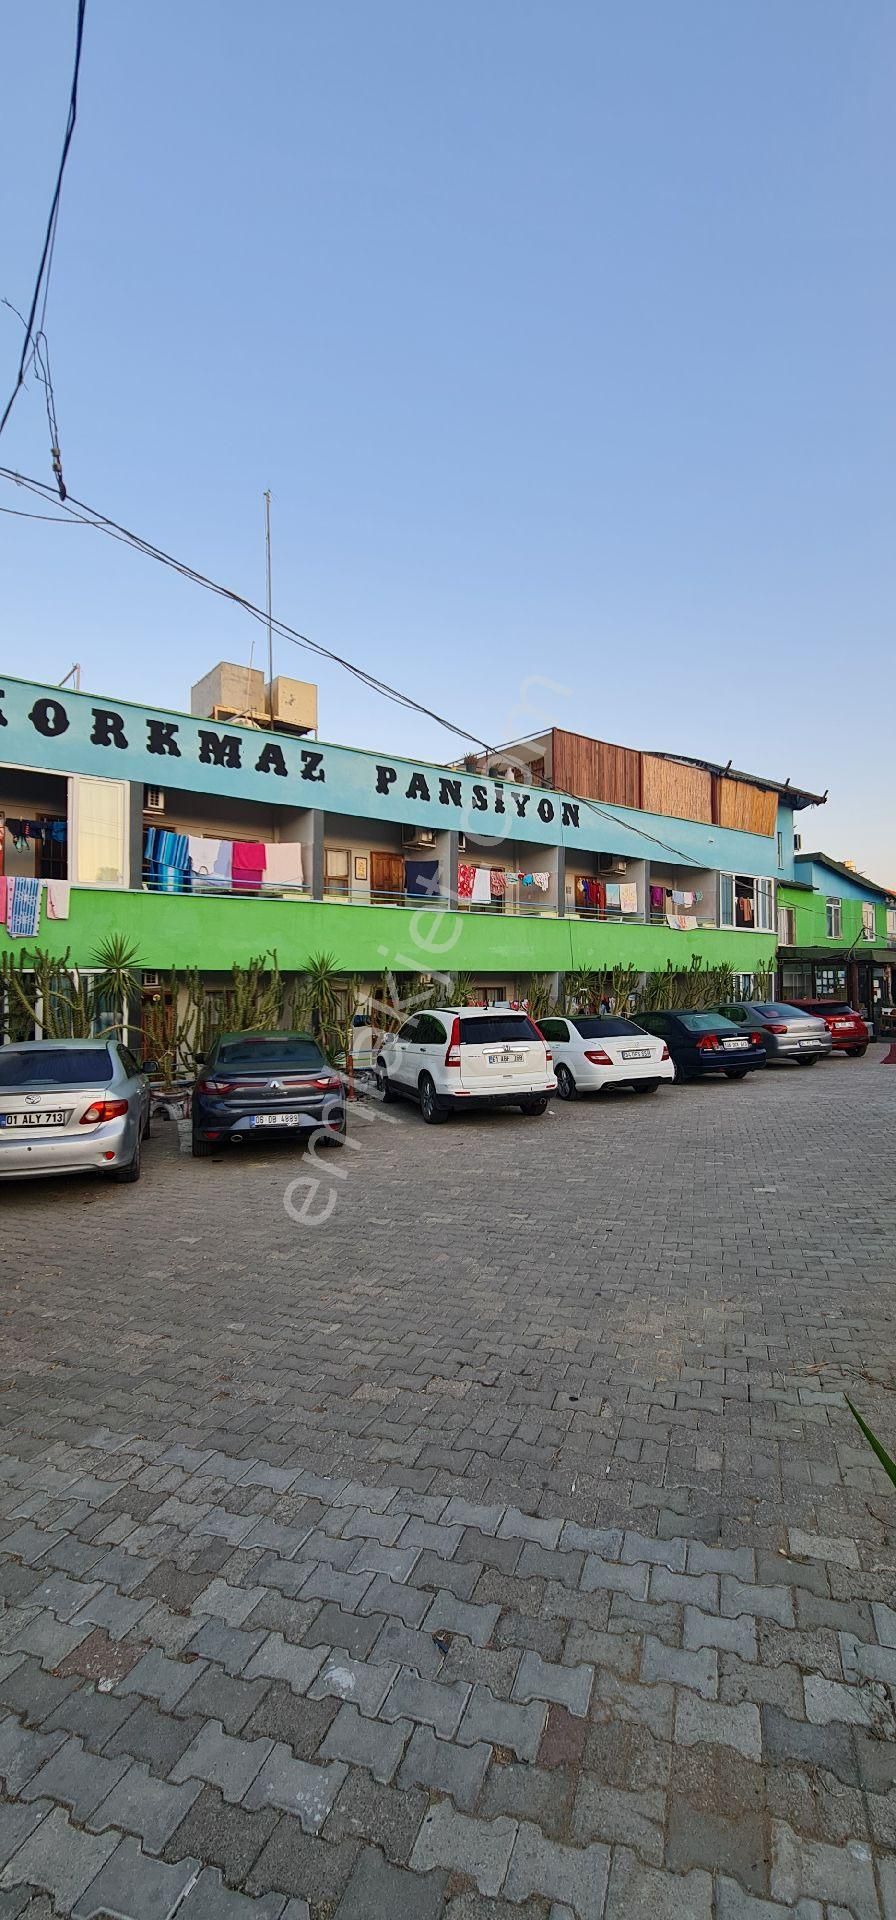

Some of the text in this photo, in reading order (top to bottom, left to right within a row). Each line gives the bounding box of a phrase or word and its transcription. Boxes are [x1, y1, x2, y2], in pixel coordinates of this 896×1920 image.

[375, 765, 580, 828] PANSİYON
[6, 1113, 63, 1125] 01 ALY 713
[256, 1115, 264, 1124] 06
